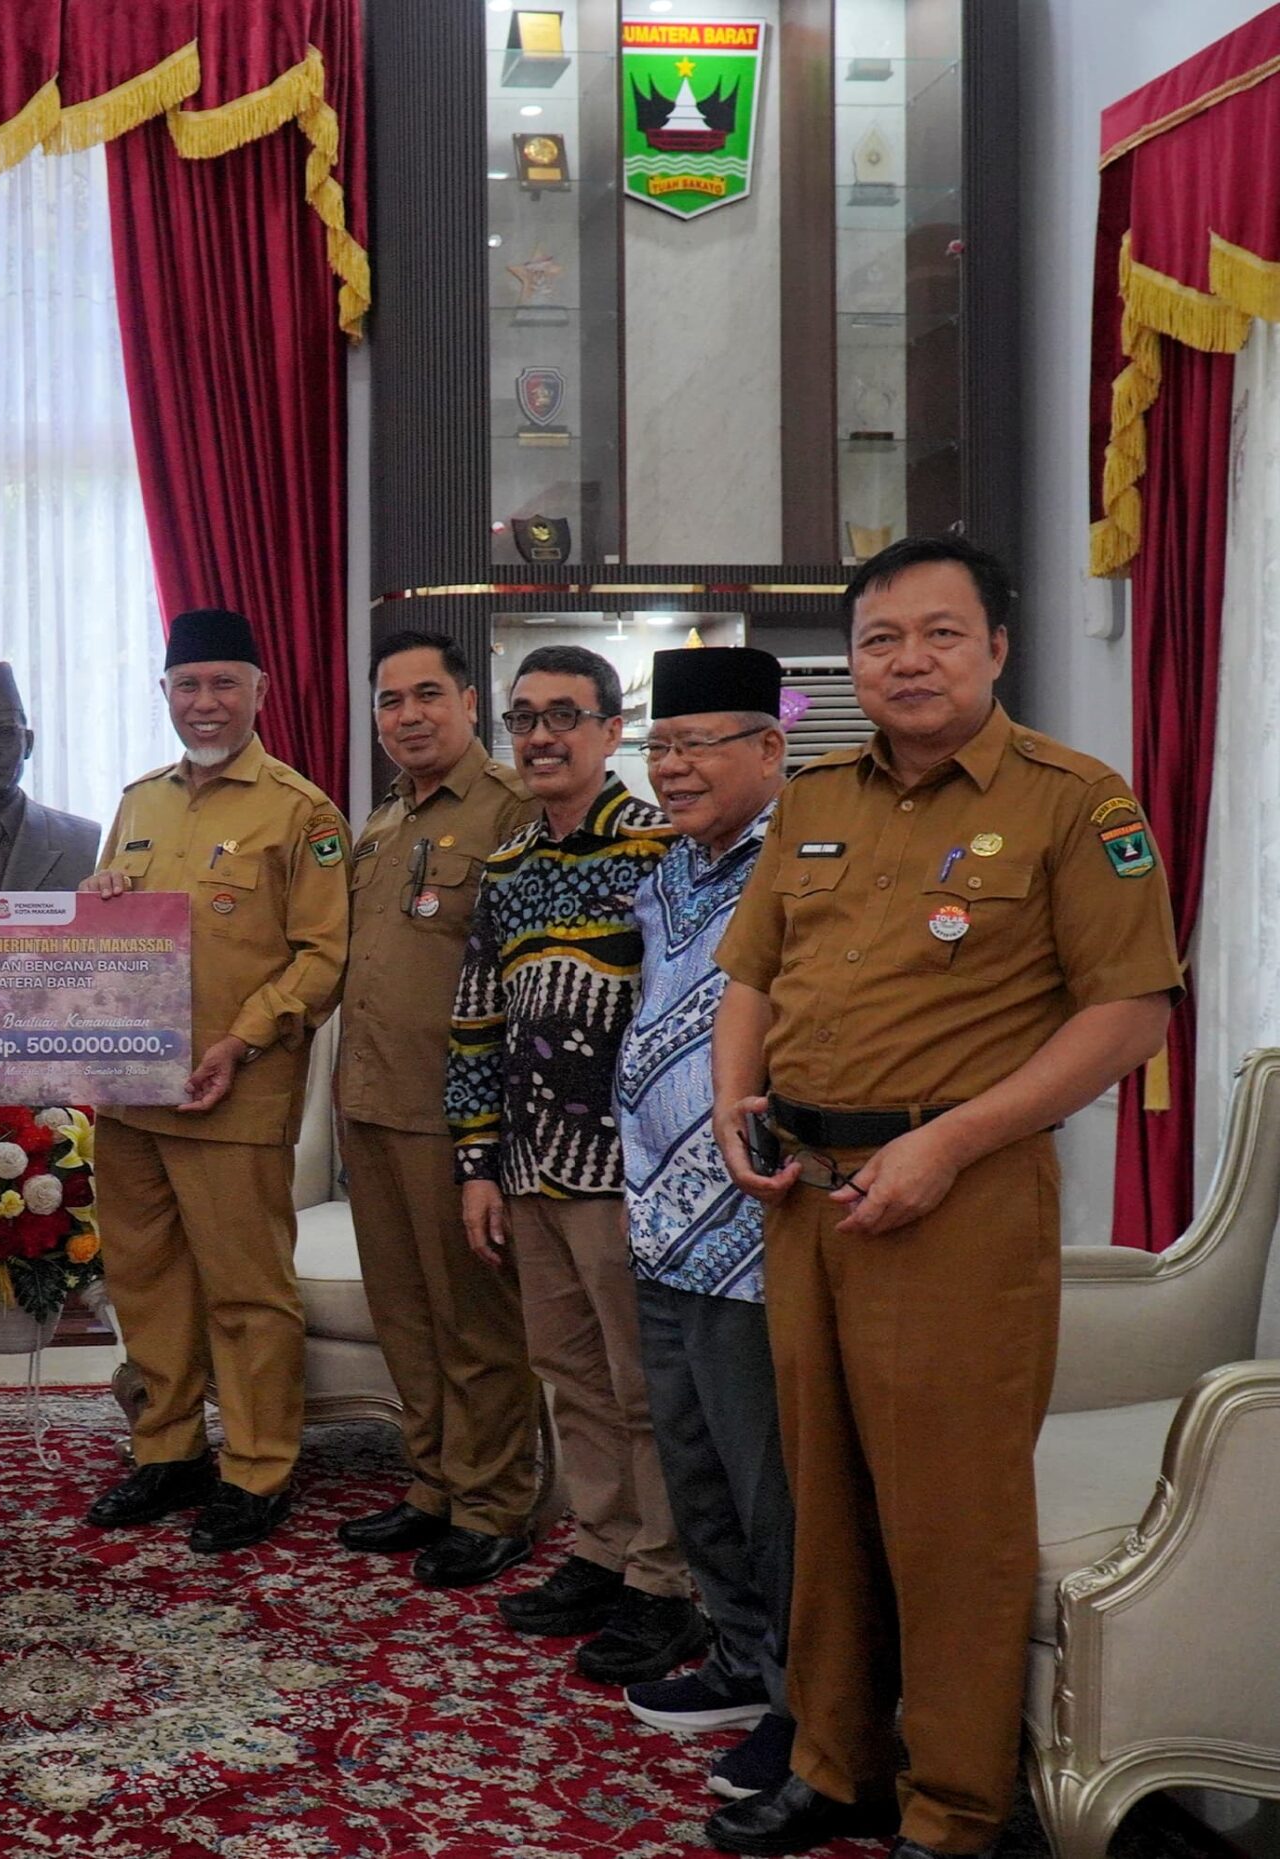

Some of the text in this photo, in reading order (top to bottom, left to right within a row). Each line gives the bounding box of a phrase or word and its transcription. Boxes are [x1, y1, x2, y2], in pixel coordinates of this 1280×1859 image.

[623, 25, 757, 45] UMATERA BARAT
[63, 937, 96, 953] KOTA
[99, 937, 175, 953] MAKASSAR
[25, 960, 94, 972] BENCANA
[97, 960, 149, 972] BANJIR
[47, 976, 93, 988] BARAT
[2, 1012, 151, 1029] Bantuan Kemanusiaan
[26, 1036, 174, 1056] 500.000.000,-
